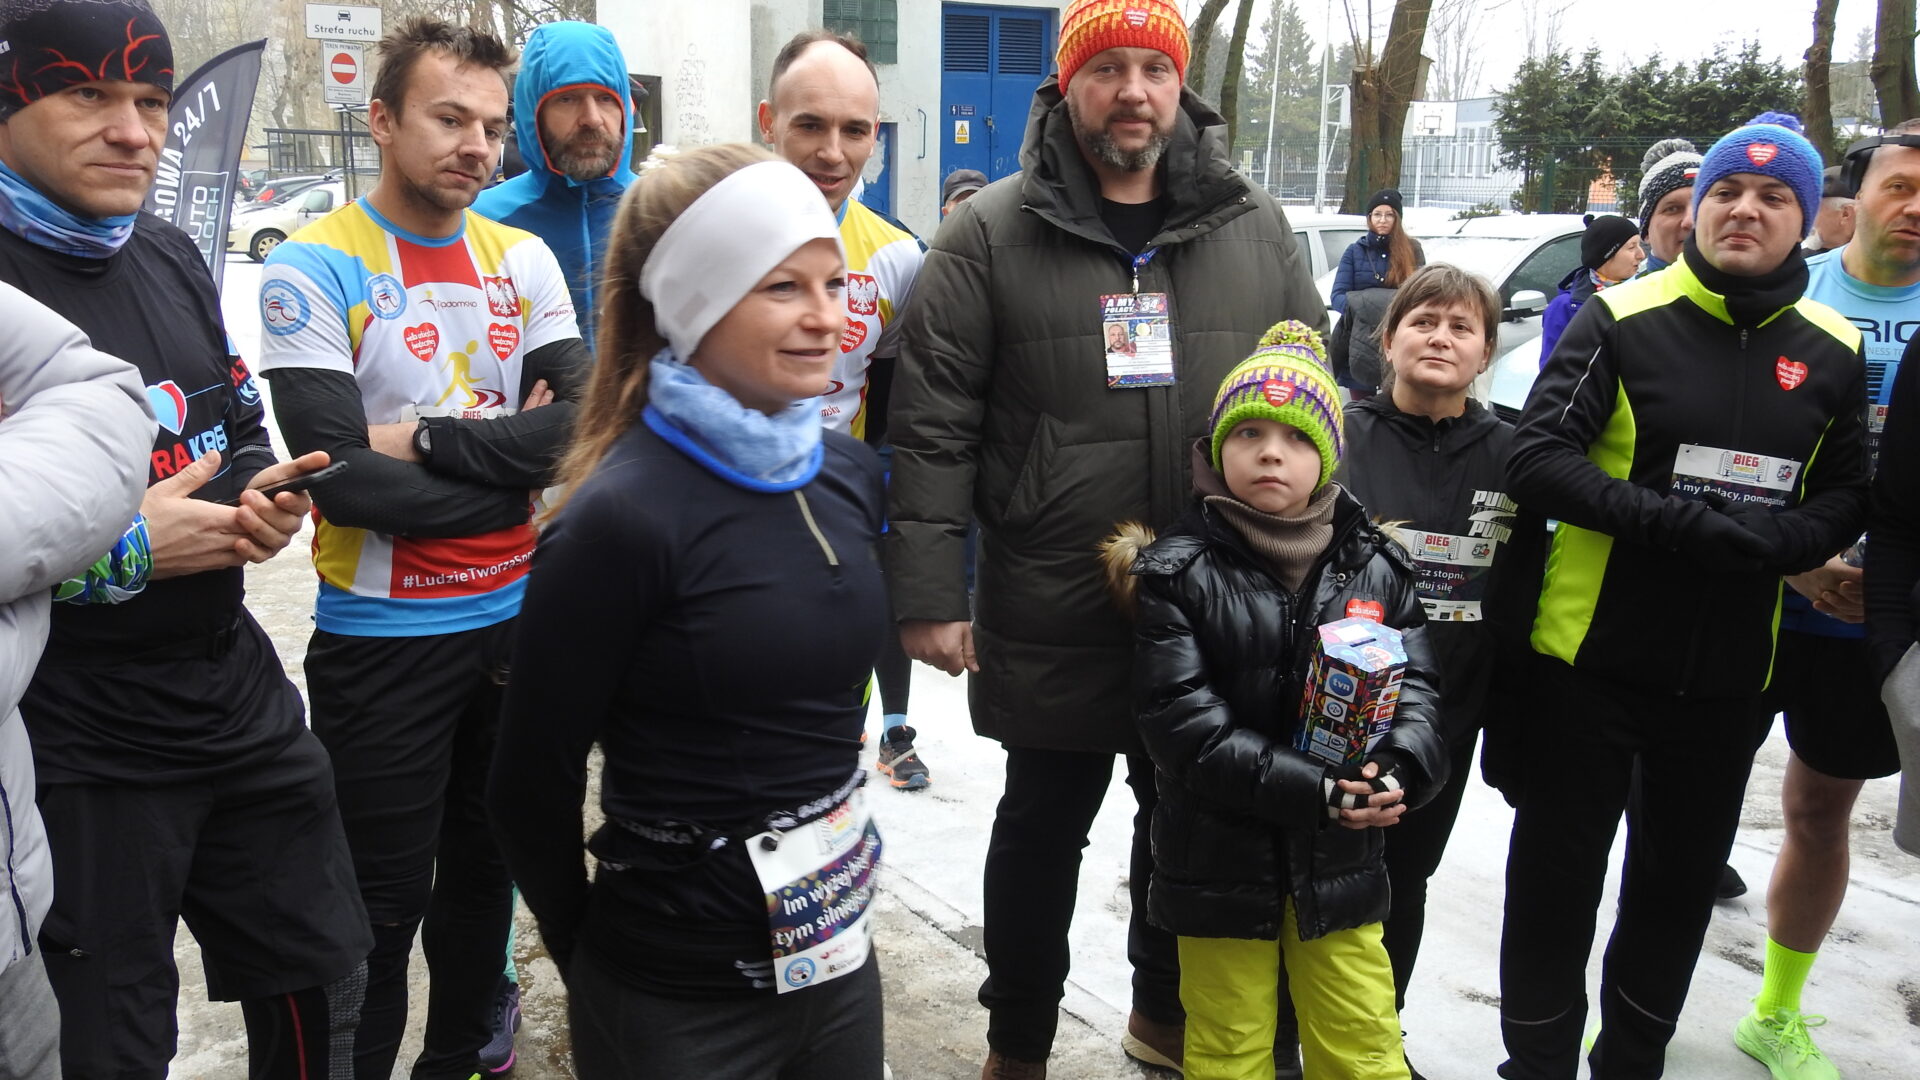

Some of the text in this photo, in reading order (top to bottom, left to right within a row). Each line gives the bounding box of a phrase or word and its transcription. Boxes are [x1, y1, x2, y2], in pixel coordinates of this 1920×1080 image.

[314, 24, 376, 36] Strefa ruchu
[174, 81, 221, 147] 24/7
[188, 186, 208, 247] UTO
[462, 410, 482, 420] BIEG
[1733, 453, 1760, 468] BIEG
[1672, 480, 1681, 490] A
[1683, 483, 1701, 495] my
[1425, 534, 1450, 547] BIEG
[1433, 569, 1465, 581] stopni,
[1332, 679, 1350, 692] tvn
[782, 895, 809, 916] Im
[774, 922, 814, 948] tym
